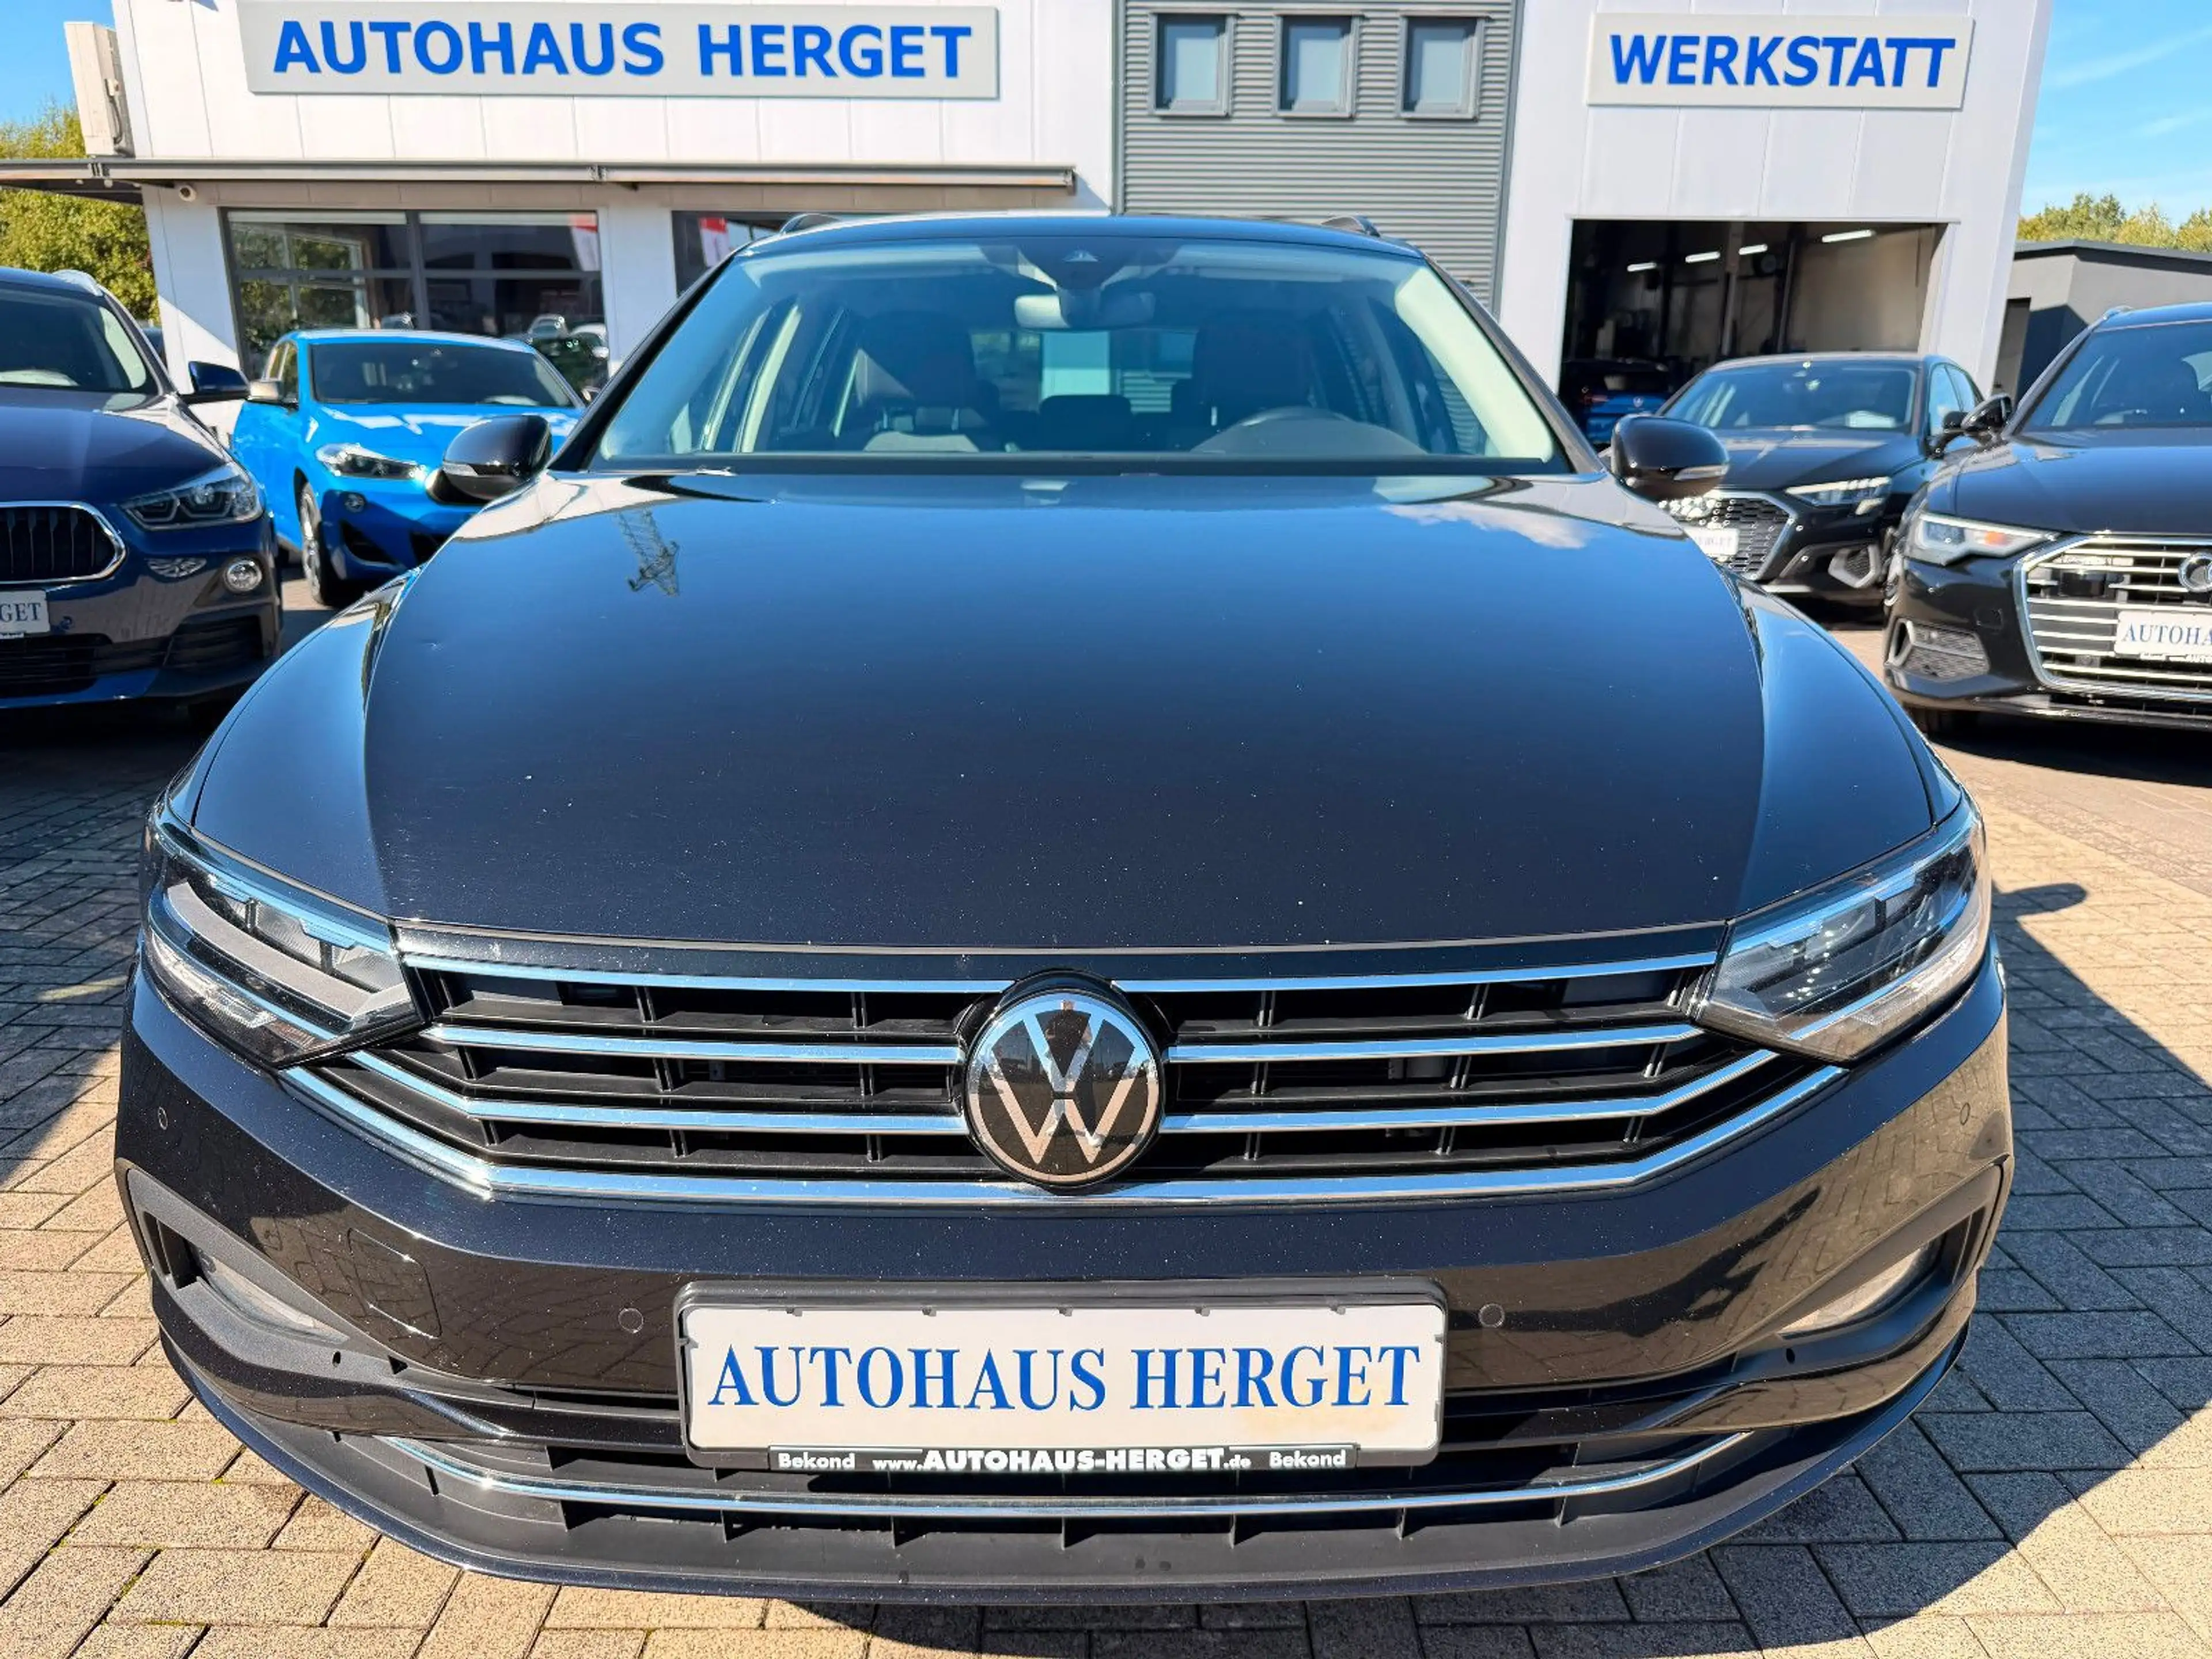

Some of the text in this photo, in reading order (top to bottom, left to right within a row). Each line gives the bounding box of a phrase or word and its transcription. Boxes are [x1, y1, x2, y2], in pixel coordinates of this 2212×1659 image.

[273, 20, 972, 79] AUTOHAUS HERGET
[1610, 34, 1956, 88] WERKSTATT
[707, 1344, 1421, 1411] AUTOHAUS HERGET
[778, 1449, 1346, 1472] Bekond www.AUTOHAUS-HERGET.de Bekond
